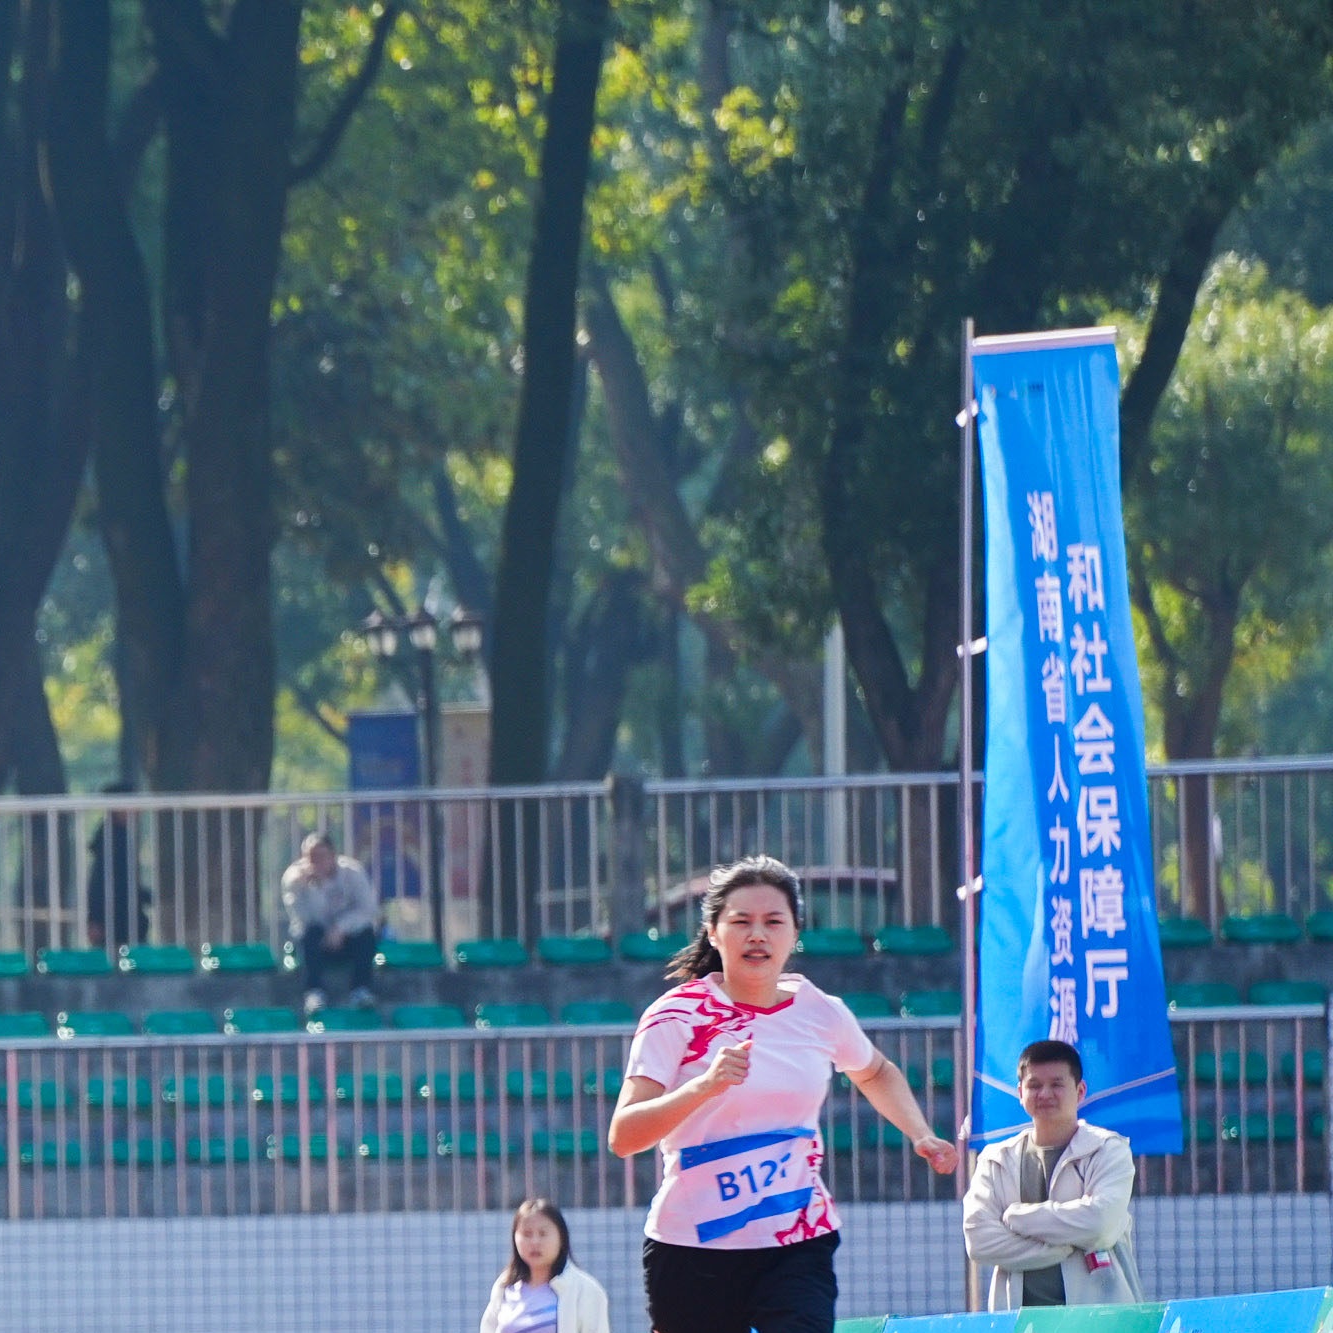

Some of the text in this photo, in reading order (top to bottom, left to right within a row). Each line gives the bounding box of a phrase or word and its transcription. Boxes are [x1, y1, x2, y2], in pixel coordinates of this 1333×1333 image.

[1026, 490, 1081, 1046] 湖南省人力资源
[1066, 543, 1130, 1019] 和社会保障厅
